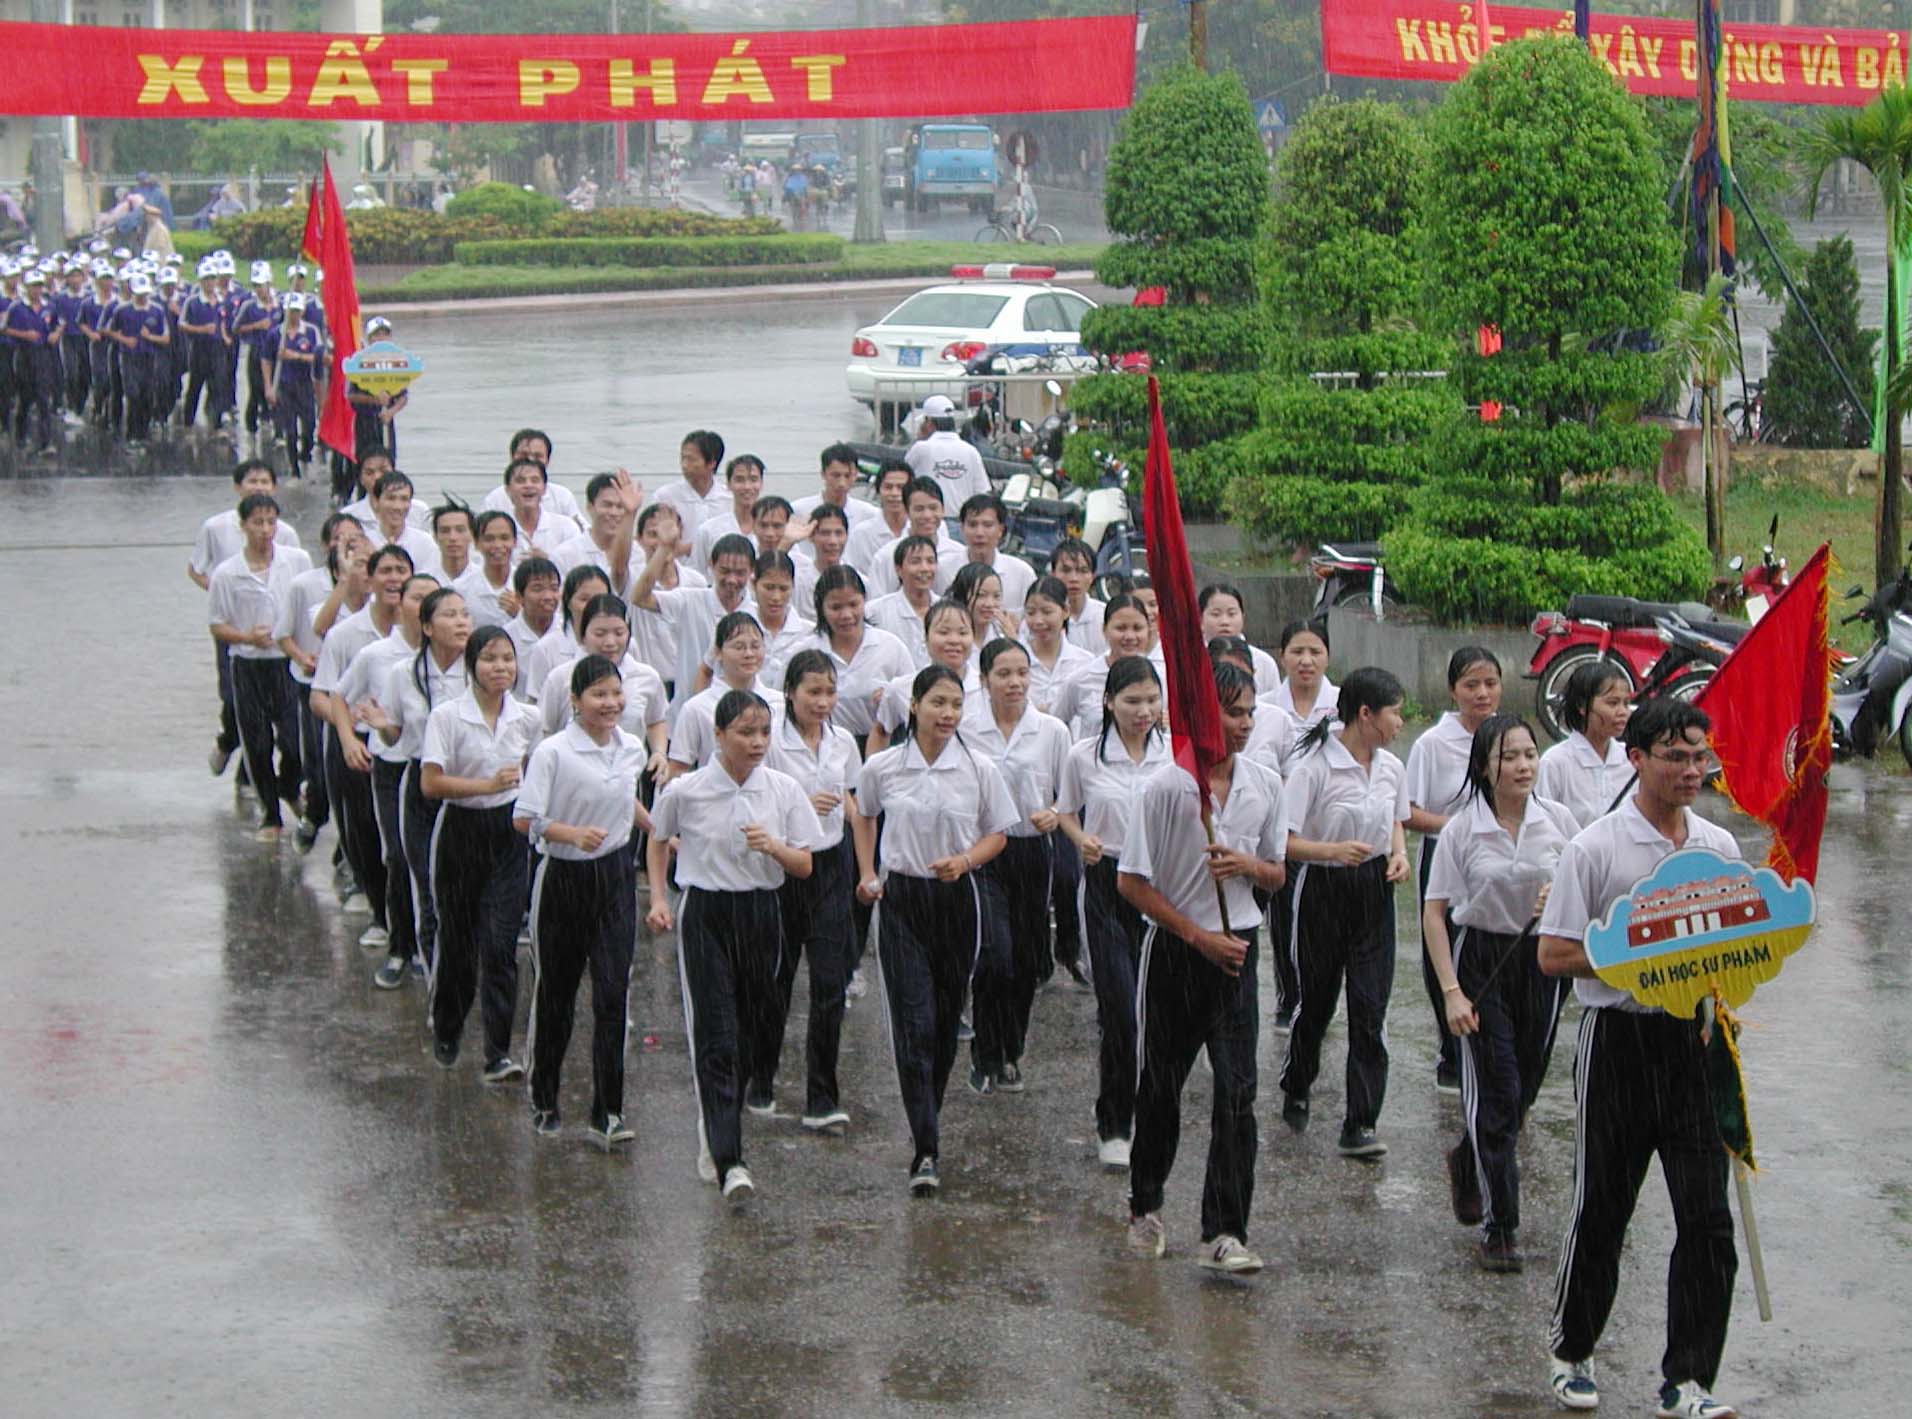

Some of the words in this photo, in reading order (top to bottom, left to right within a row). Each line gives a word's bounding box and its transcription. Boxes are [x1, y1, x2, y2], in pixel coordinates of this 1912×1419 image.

[137, 36, 448, 106] XUẤT
[519, 39, 846, 107] PHÁT
[1590, 25, 1663, 79] XÂY
[1800, 34, 1845, 87] VÀ
[1668, 961, 1698, 983] HỌC
[1722, 943, 1771, 970] PHẠM
